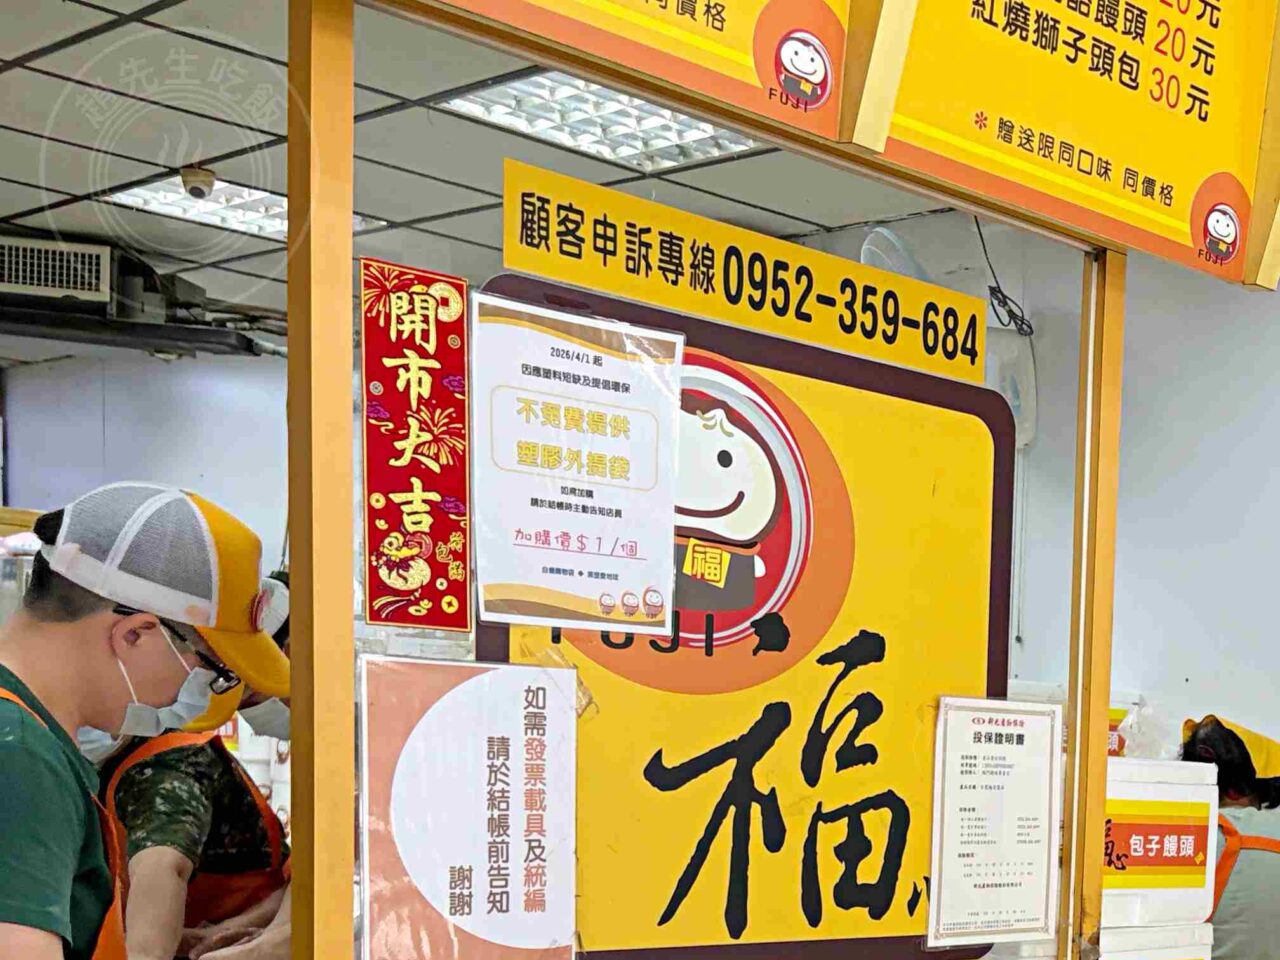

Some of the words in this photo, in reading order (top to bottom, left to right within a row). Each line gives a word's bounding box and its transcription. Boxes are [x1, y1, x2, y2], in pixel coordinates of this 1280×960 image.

[769, 87, 808, 113] FUJI
[997, 117, 1113, 183] 贈送限同口味
[1123, 168, 1174, 208] 同價格
[519, 191, 716, 295] 顧客申訴專線
[722, 245, 979, 366] 0952-359-684
[1197, 248, 1225, 267] FUJI
[550, 346, 590, 365] 2026/4/1
[382, 291, 443, 534] 開市大吉
[516, 397, 631, 440] 不免費提供
[690, 545, 724, 585] 福
[973, 731, 1026, 746] 投保證明書
[643, 612, 930, 939] 福
[523, 685, 547, 914] 如需發票載具及統編
[486, 736, 511, 915] 請於結帳前告知
[1129, 834, 1195, 857] 包子饅頭
[449, 866, 474, 917] 謝謝
